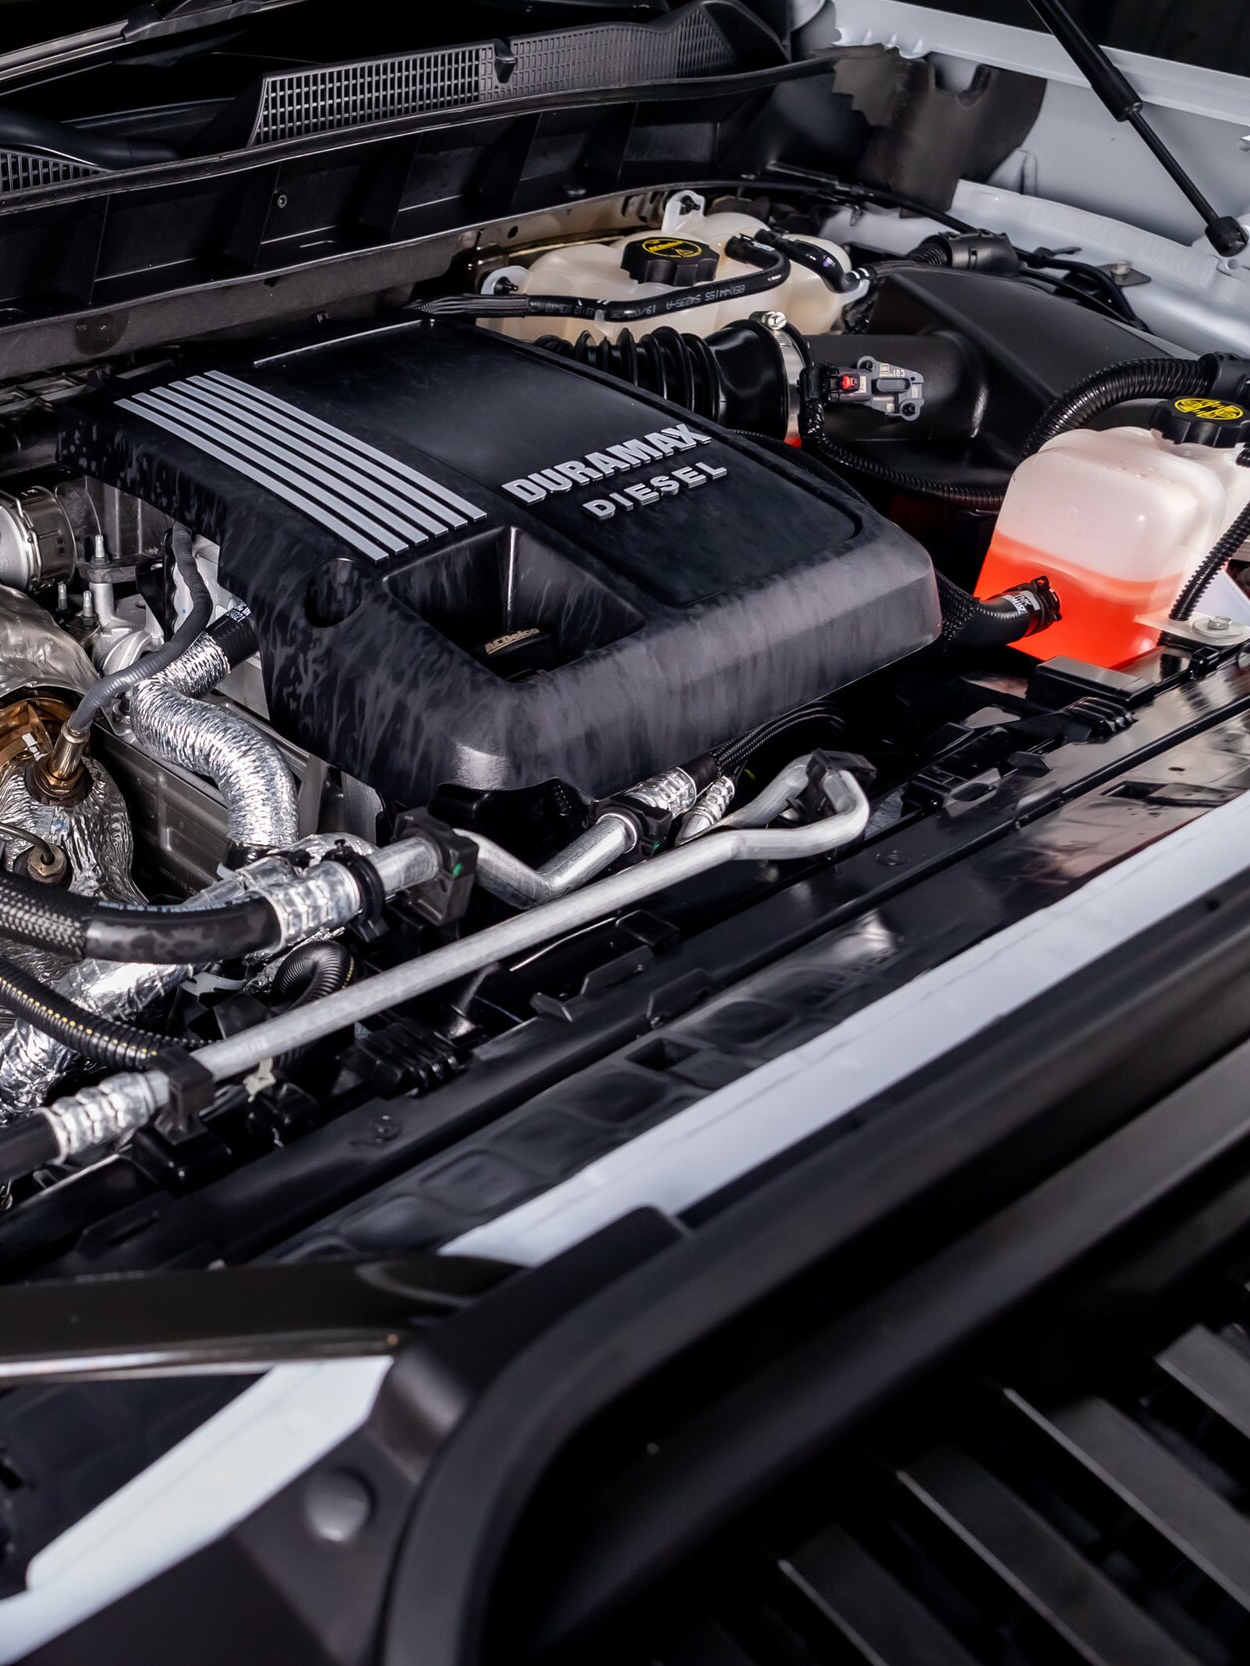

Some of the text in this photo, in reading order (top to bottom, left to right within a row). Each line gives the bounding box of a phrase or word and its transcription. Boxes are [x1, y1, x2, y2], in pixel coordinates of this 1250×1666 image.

[501, 423, 712, 505] DURAMAX
[582, 461, 727, 520] DIESEL
[485, 628, 540, 653] ACDelco
